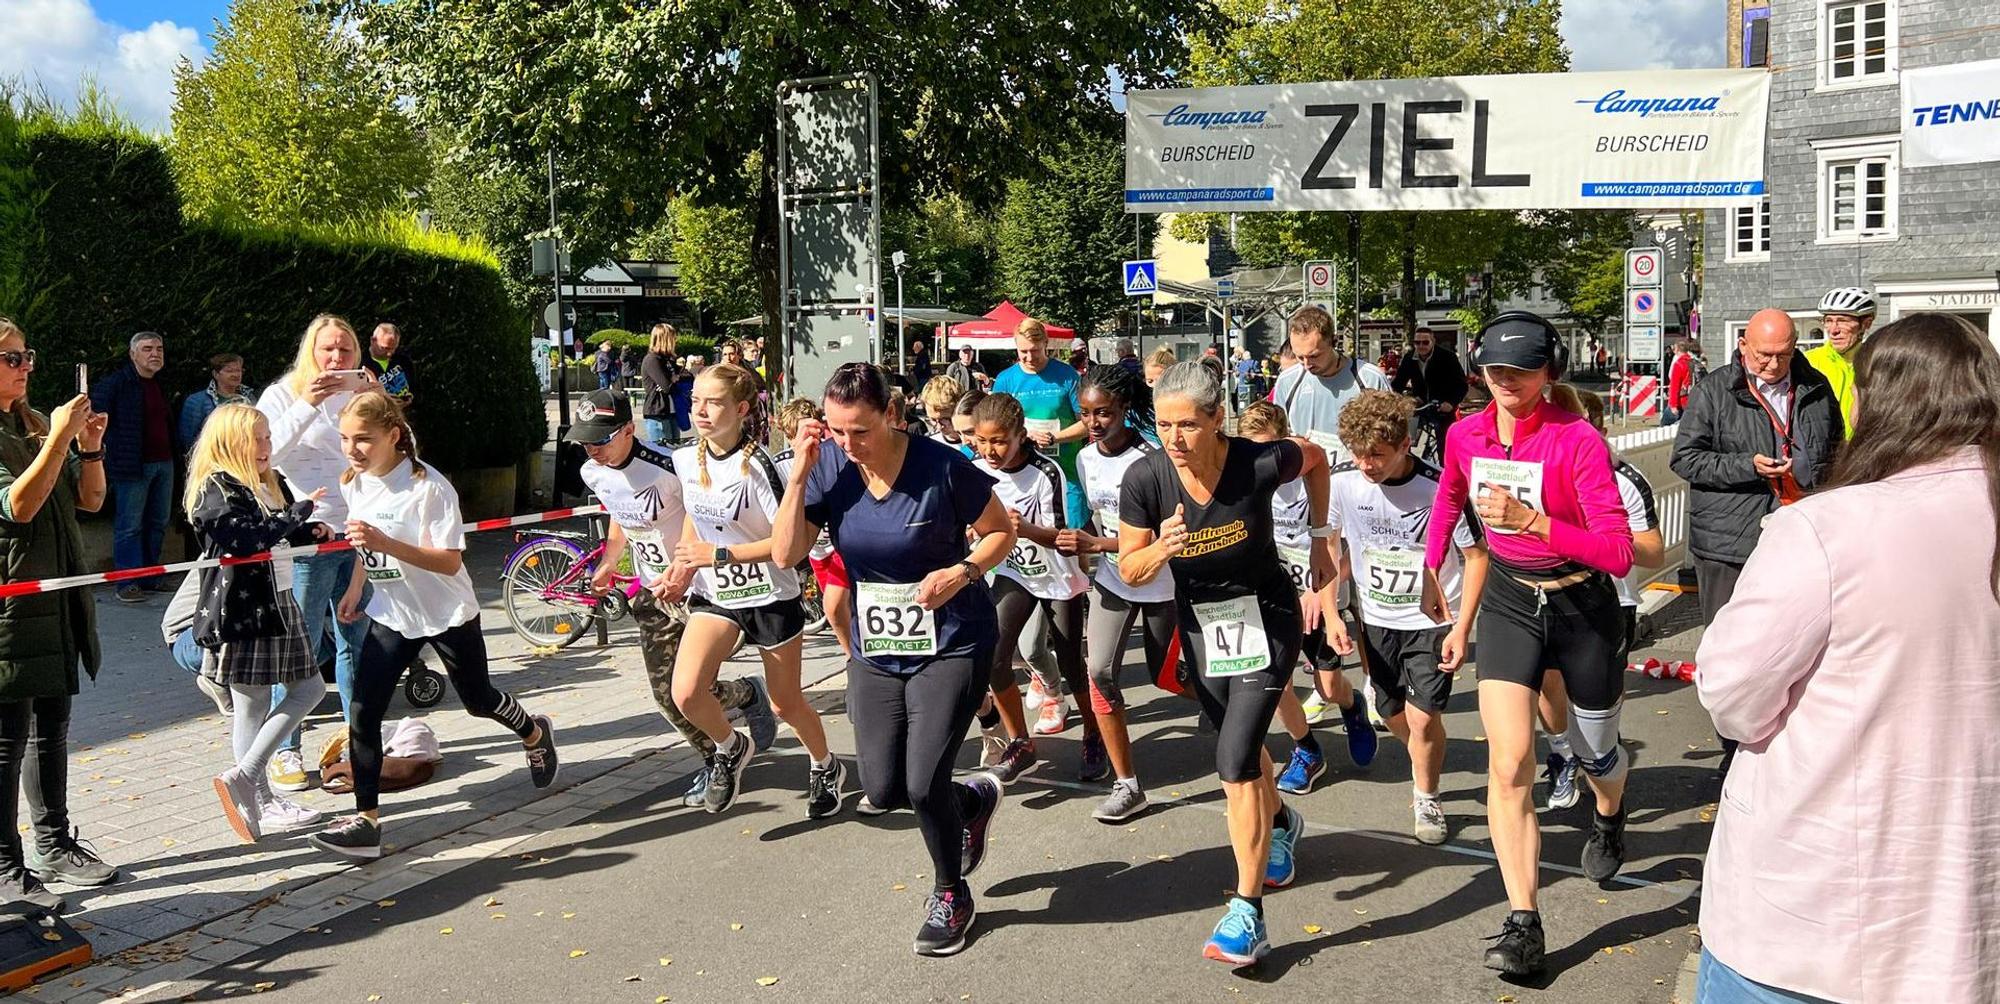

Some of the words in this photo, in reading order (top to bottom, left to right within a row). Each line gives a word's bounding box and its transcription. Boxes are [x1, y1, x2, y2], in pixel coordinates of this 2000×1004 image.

[1577, 90, 1720, 117] Campana
[1147, 104, 1267, 129] Campana
[1161, 144, 1255, 163] BURSCHEID
[1301, 100, 1531, 190] ZIEL
[1596, 134, 1709, 153] BURSCHEID
[1138, 187, 1266, 201] www.campanaradsportde
[1594, 181, 1750, 196] www.campanaradsportde
[1639, 260, 1651, 271] 20
[1315, 271, 1325, 281] 20
[584, 286, 627, 294] SCHIRME
[617, 511, 646, 521] SCHULE
[694, 504, 726, 518] SCHULE
[1188, 520, 1245, 542] uffreunde
[1371, 526, 1410, 540] SCHULE
[628, 538, 664, 564] 83
[714, 561, 765, 589] 584
[1280, 560, 1311, 588] 80
[1370, 565, 1419, 594] 577
[866, 605, 927, 637] 632
[1216, 621, 1245, 657] 47
